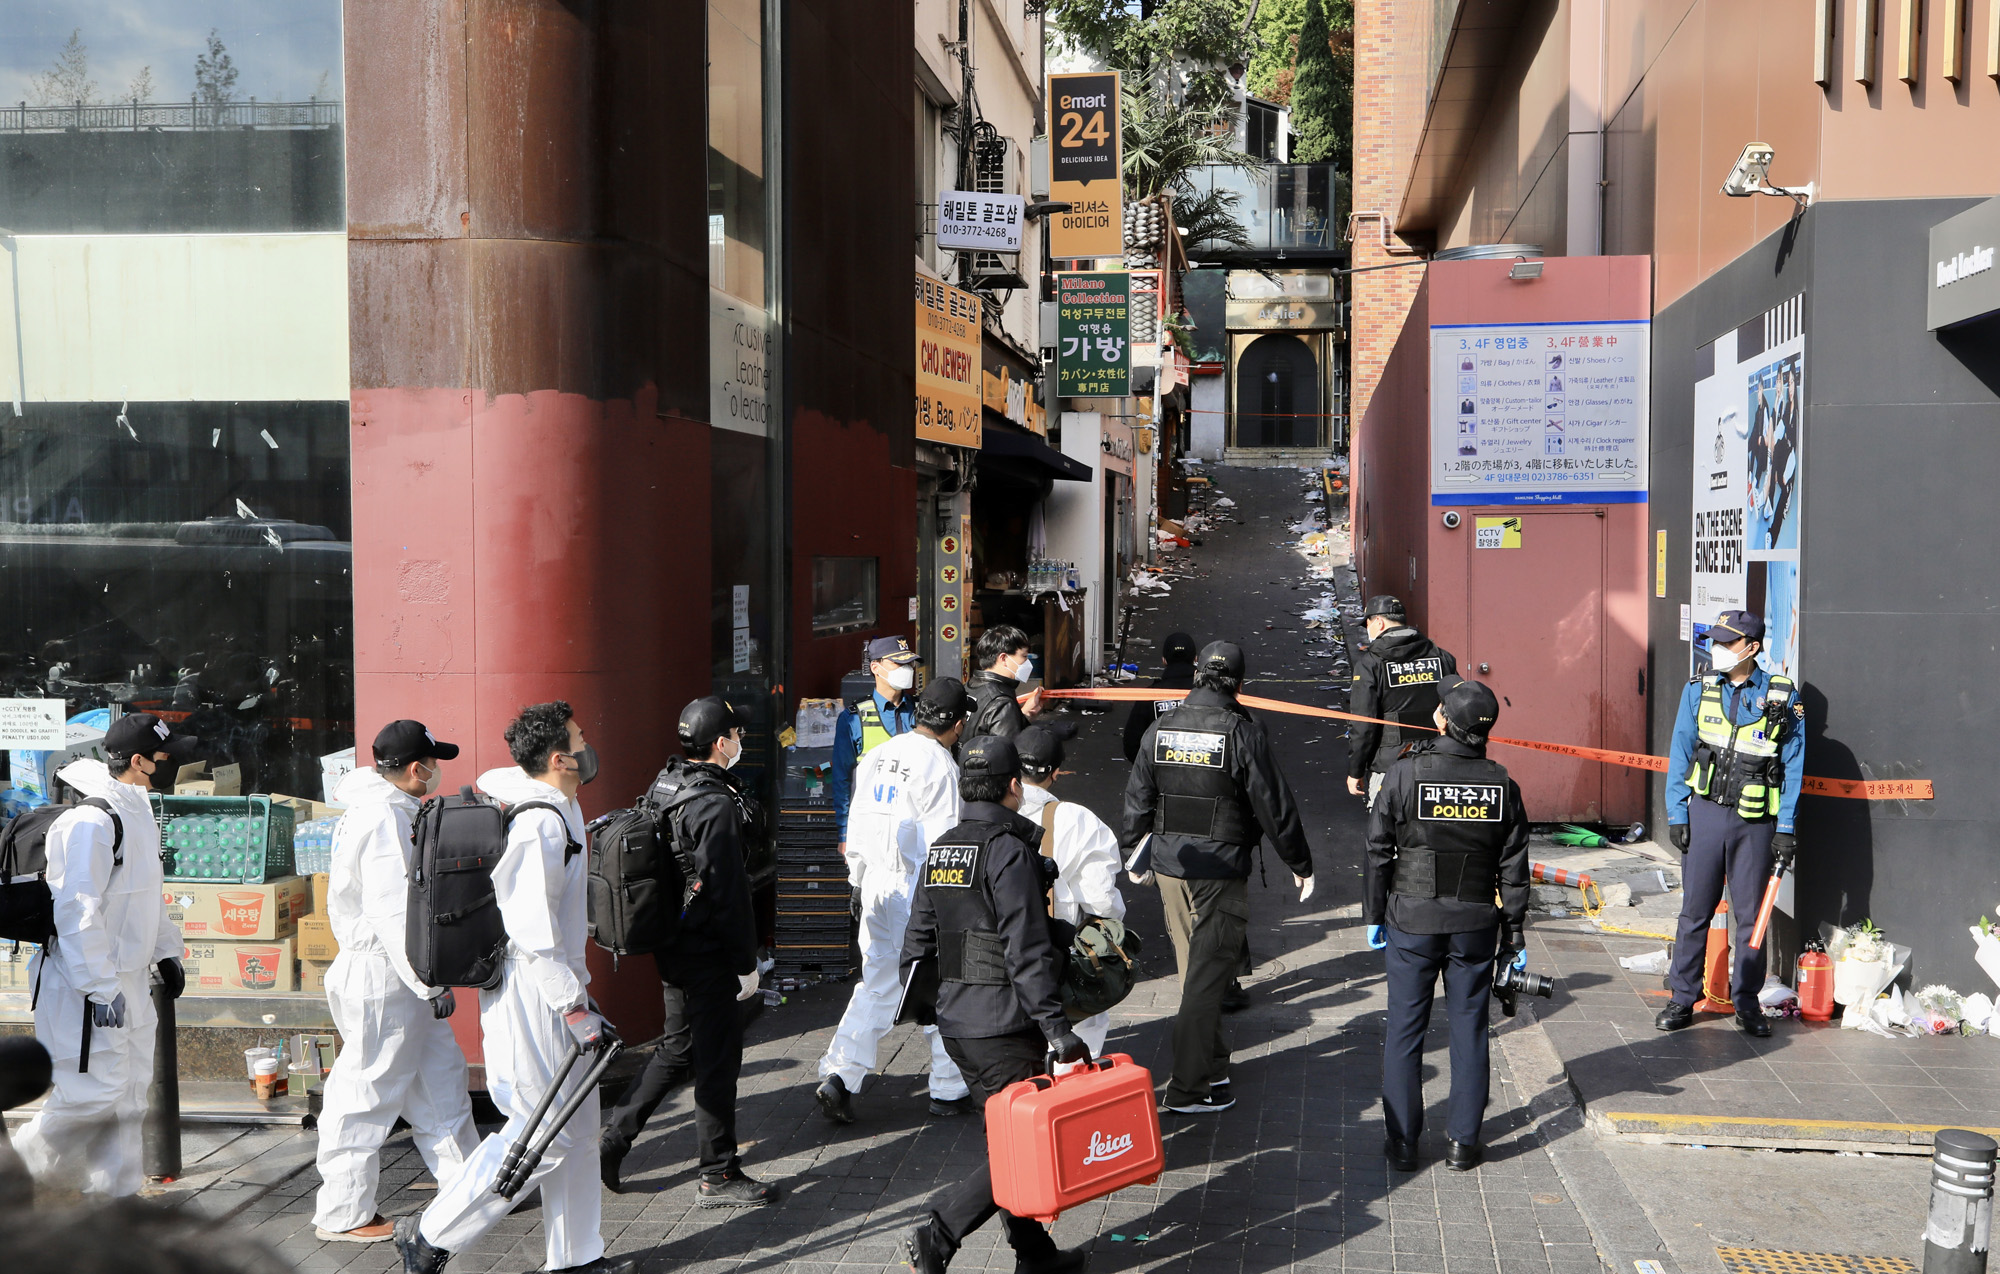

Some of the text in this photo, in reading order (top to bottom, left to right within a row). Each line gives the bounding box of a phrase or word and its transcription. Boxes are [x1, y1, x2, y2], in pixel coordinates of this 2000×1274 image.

[1060, 93, 1107, 110] emart
[1060, 110, 1110, 148] 24
[1061, 155, 1109, 164] DELICIOUS IDEA
[943, 200, 1018, 225] 해밀톤 골프샵
[1062, 215, 1110, 229] 아이디어
[942, 225, 1007, 238] 010-3772-4268
[1007, 237, 1017, 245] B1
[1061, 277, 1105, 290] Milano
[915, 276, 945, 314] 해밀톤
[1061, 292, 1125, 304] Collection
[1061, 308, 1126, 320] 여성구두전문
[1258, 309, 1302, 320] Atelier
[1078, 323, 1112, 335] 여행용
[1475, 338, 1490, 349] 4F
[1494, 337, 1529, 350] 영업중
[1560, 336, 1576, 348] 4F
[1062, 337, 1126, 363] 가방
[921, 339, 972, 385] CHO JEWERY
[937, 400, 956, 432] Bag,
[1484, 472, 1594, 482] 4F 임대문의 02)3786-6351
[1696, 508, 1742, 538] ON THE SCENE
[1478, 529, 1500, 537] CCTV
[1478, 539, 1500, 547] 촬영중
[1696, 540, 1718, 573] SINCE
[1721, 539, 1742, 574] 1974
[1390, 660, 1437, 674] 과학수사
[1398, 672, 1434, 684] POLICE
[1166, 750, 1211, 764] POLICE
[1867, 783, 1914, 795] 경찰통제선
[1424, 787, 1497, 805] 과학수사
[1433, 805, 1488, 818] POLICE
[929, 848, 973, 867] 과학수사
[931, 869, 964, 883] POLICE
[224, 908, 260, 922] 새우탕
[192, 949, 215, 958] 농심
[1083, 1130, 1134, 1166] Leica
